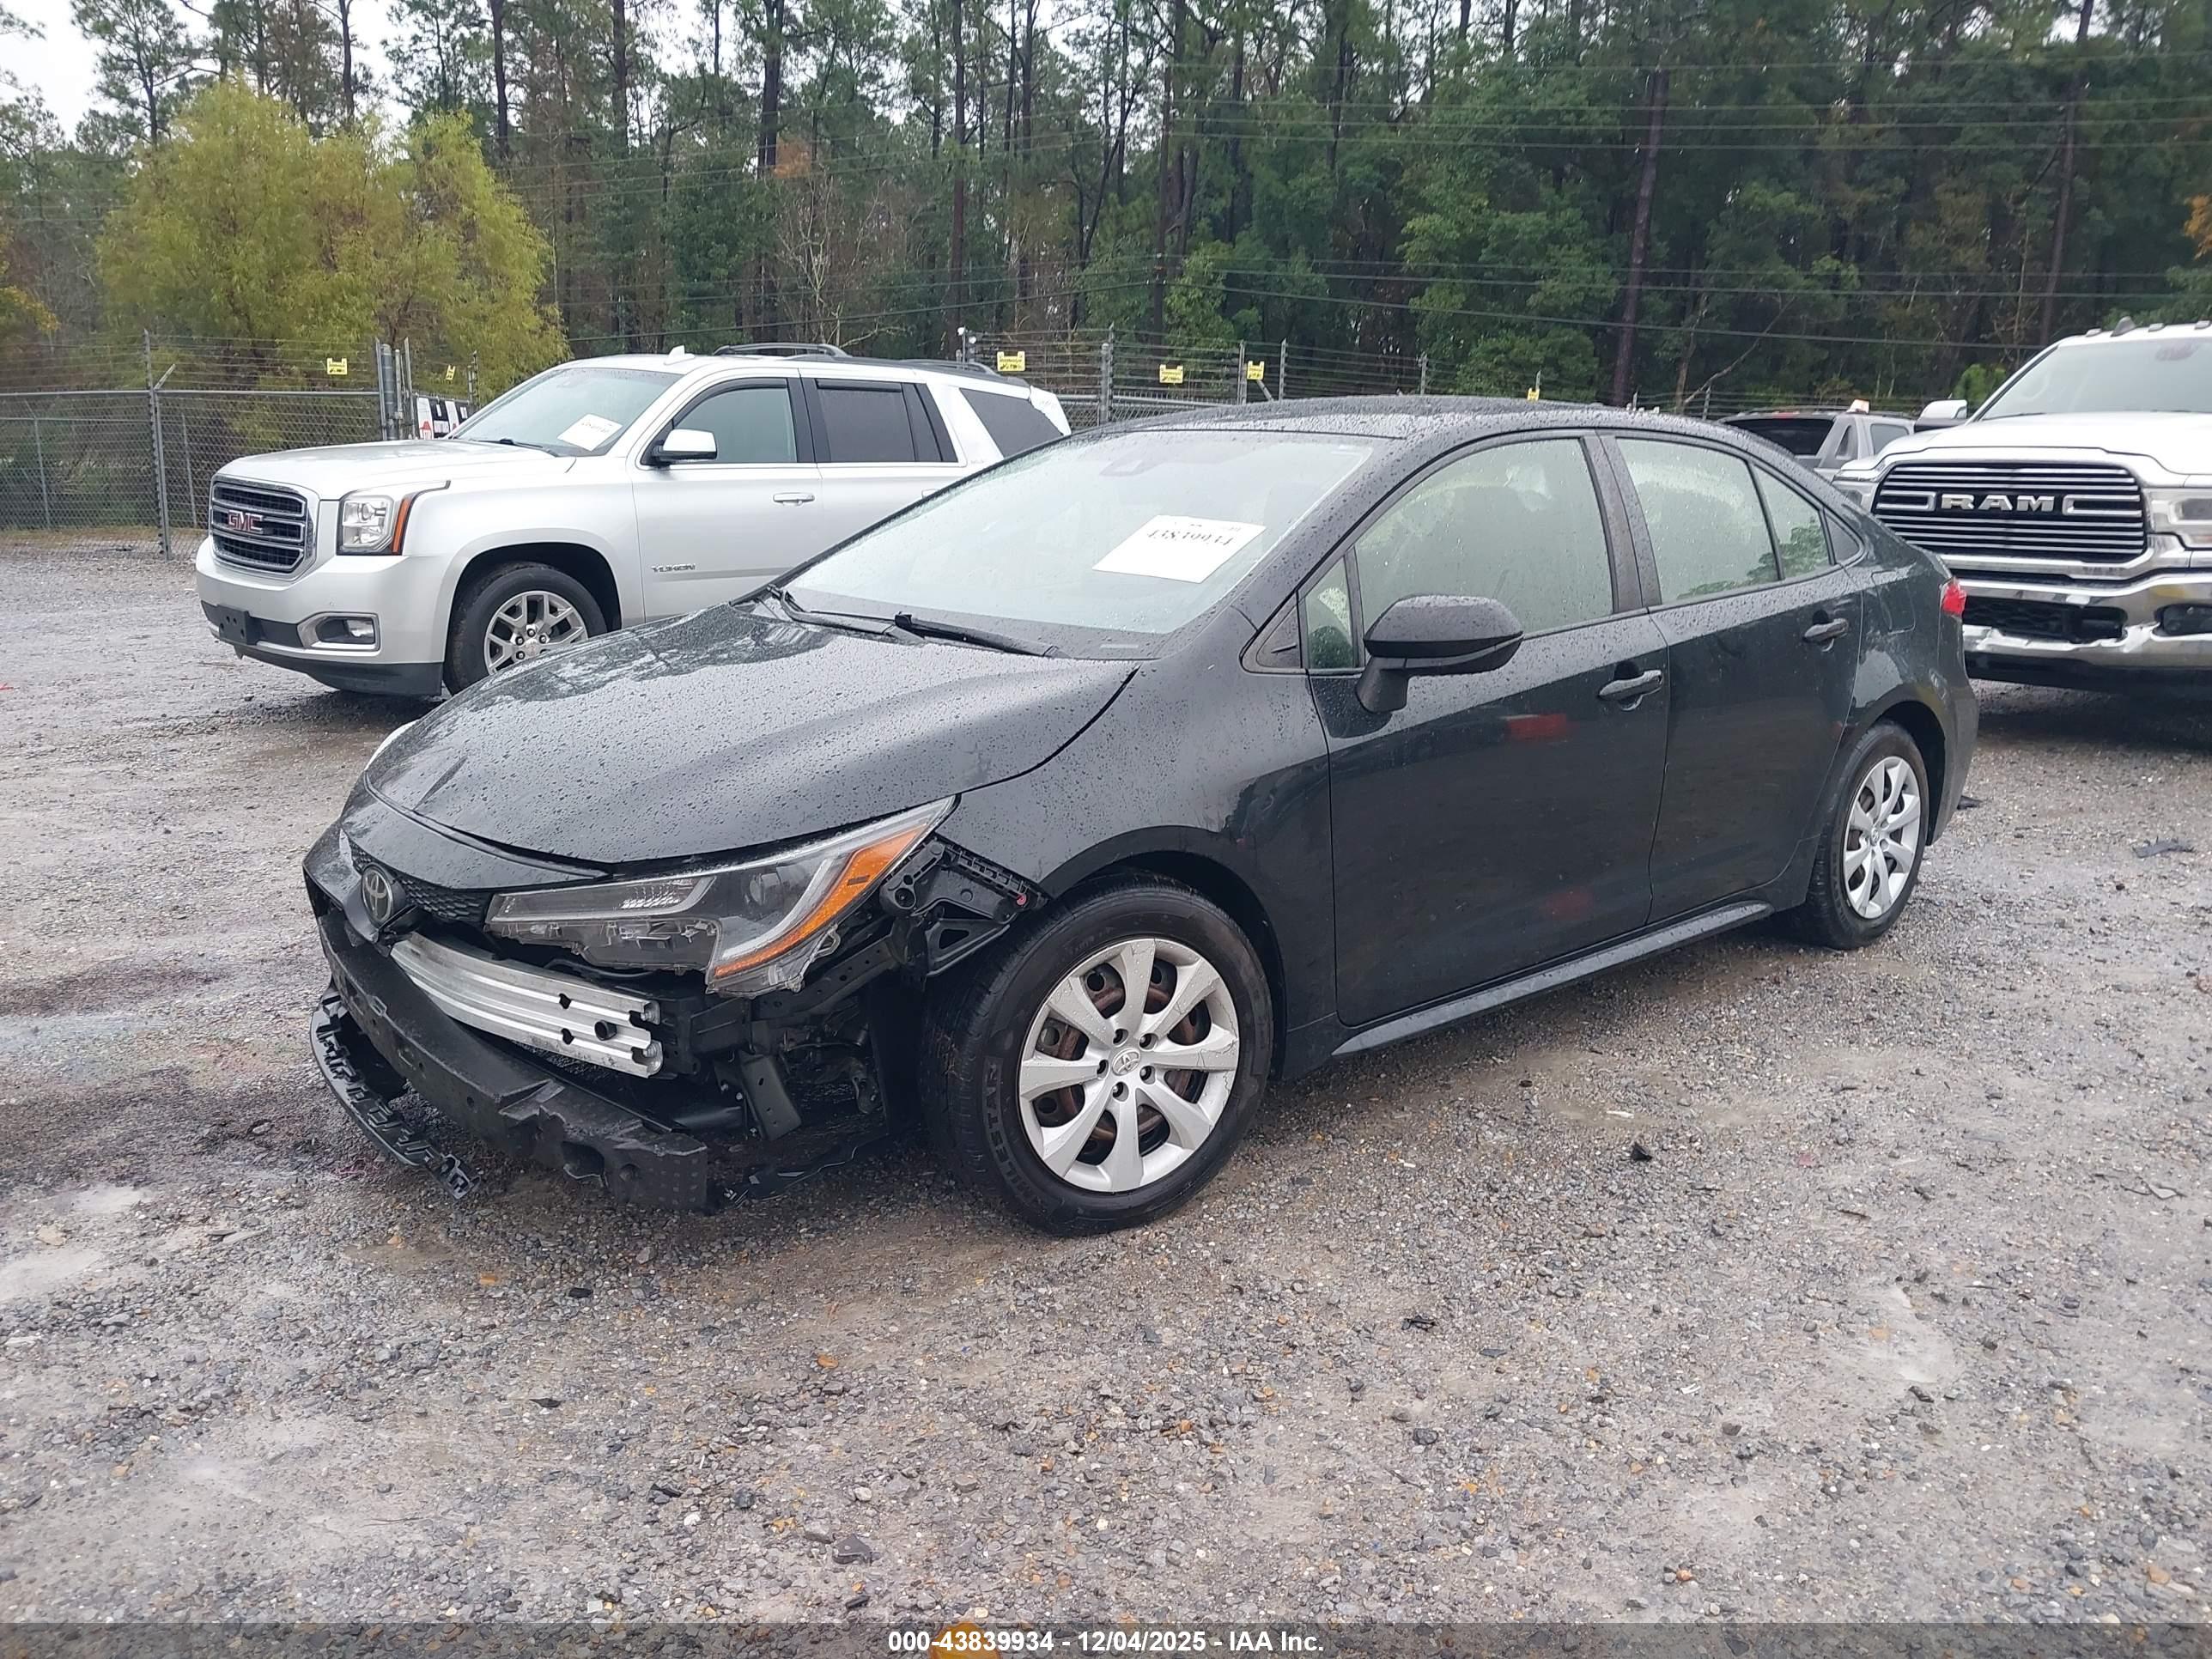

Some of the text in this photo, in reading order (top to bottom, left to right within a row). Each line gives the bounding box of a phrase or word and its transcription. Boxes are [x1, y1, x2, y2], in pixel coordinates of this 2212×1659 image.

[1941, 494, 2055, 513] RAM
[228, 509, 264, 532] GMC
[651, 563, 696, 574] YUKON
